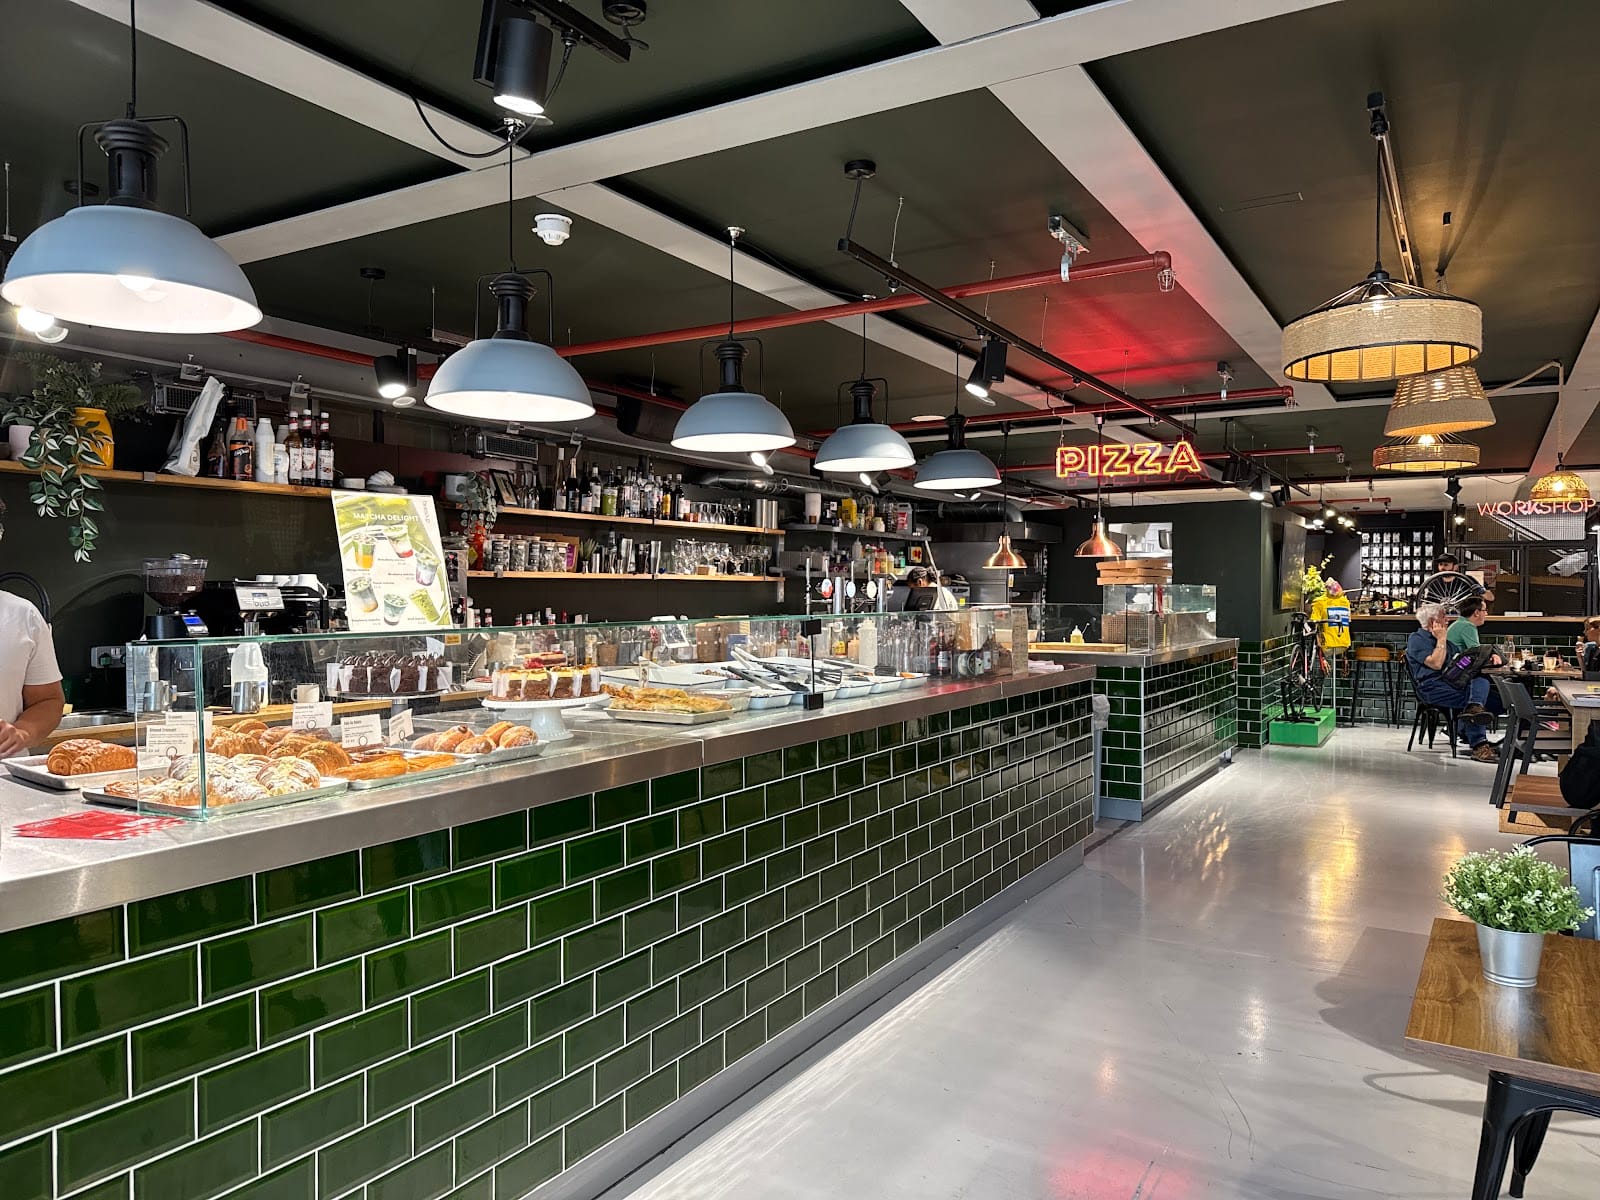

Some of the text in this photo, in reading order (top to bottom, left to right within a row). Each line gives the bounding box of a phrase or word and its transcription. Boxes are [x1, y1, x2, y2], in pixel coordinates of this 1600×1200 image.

[1056, 441, 1201, 478] PIZZA
[353, 512, 418, 522] MATCHA DELIGHT
[1476, 498, 1597, 517] WORKSHOP
